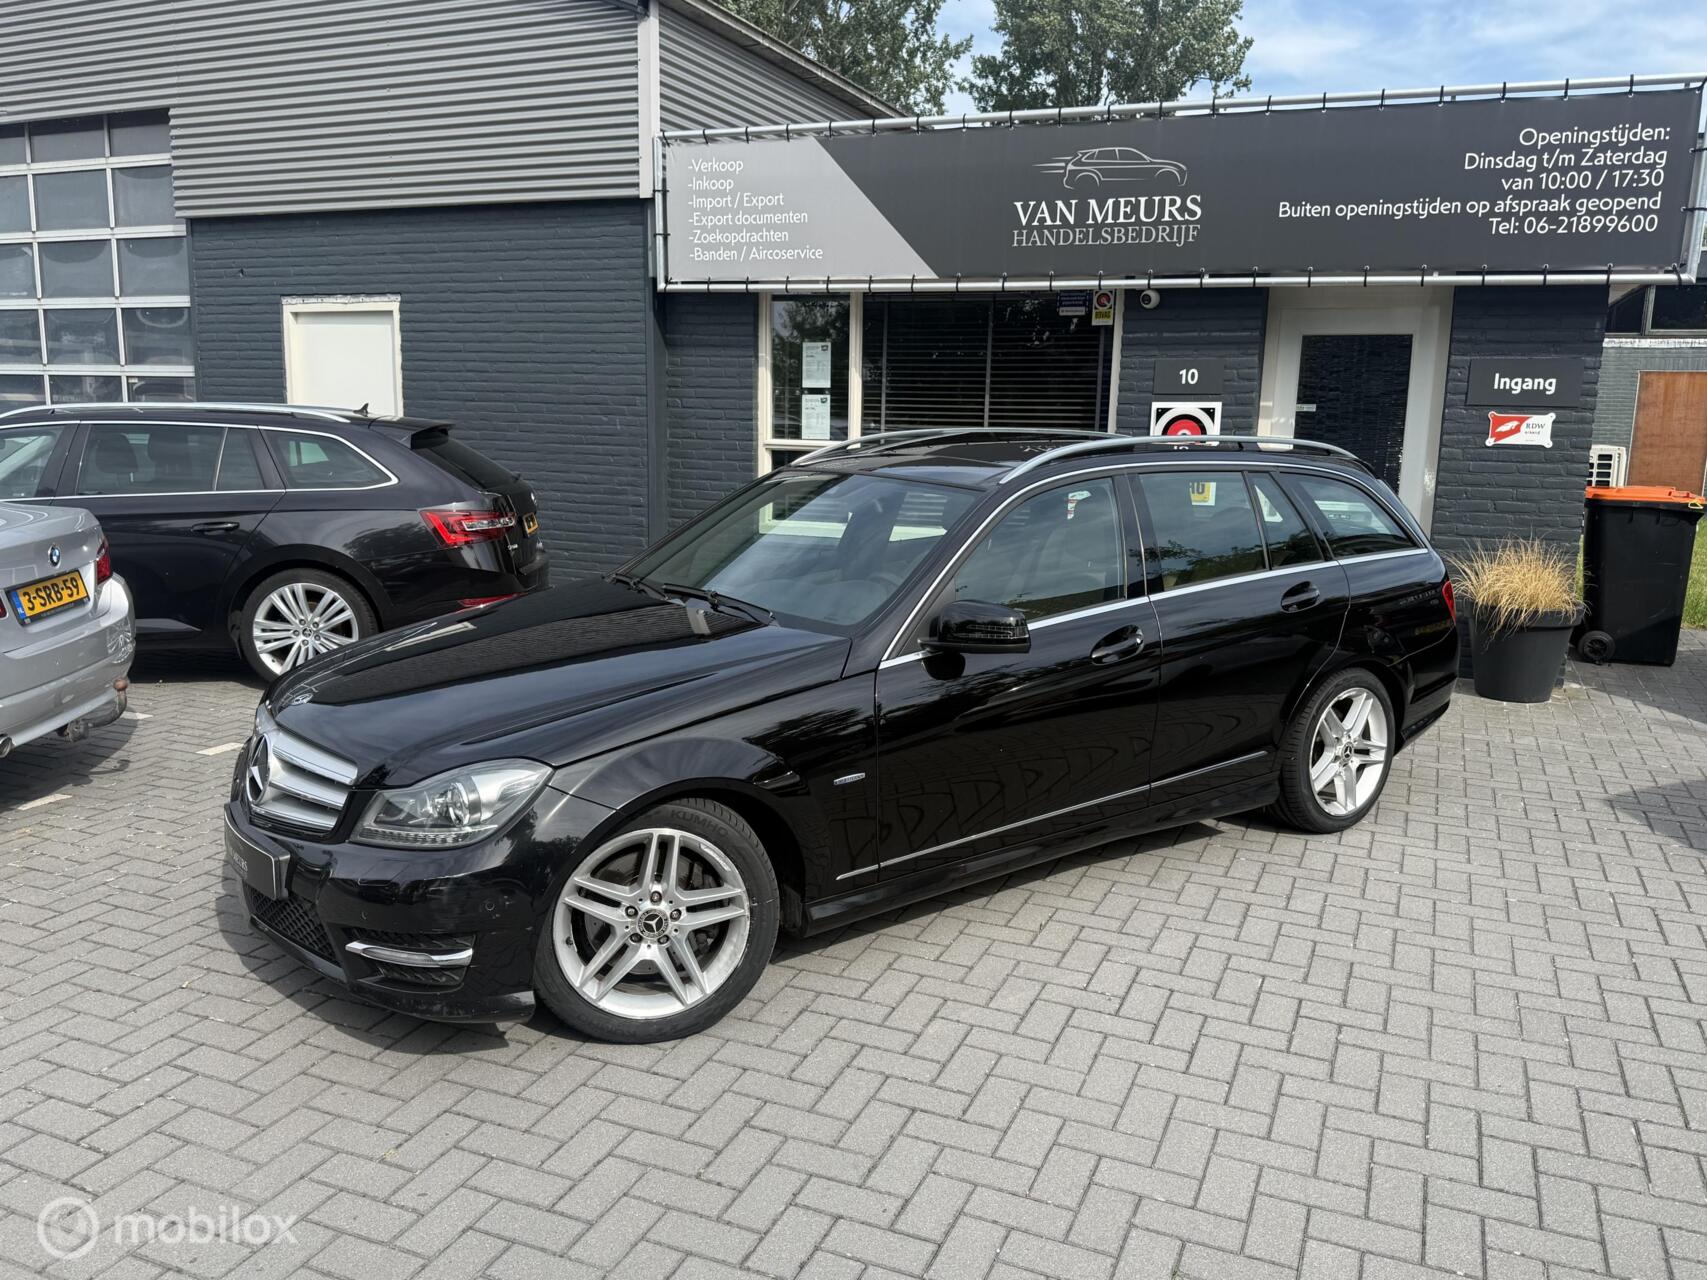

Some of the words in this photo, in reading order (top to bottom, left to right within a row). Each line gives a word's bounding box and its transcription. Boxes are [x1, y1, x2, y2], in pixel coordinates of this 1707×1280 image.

[1519, 123, 1671, 149] Openingstijden:
[687, 157, 743, 175] -Verkoop
[1464, 150, 1537, 172] Dinsdag
[1542, 149, 1575, 169] t/m
[1580, 146, 1667, 168] Zaterdag
[687, 176, 734, 193] -Inkoop
[1502, 177, 1533, 190] van
[1539, 170, 1592, 190] 10:00
[1596, 169, 1607, 190] /
[1612, 168, 1665, 188] 17:30
[688, 194, 732, 211] -Import
[734, 192, 741, 208] /
[743, 193, 784, 210] Export
[1013, 199, 1079, 226] VAN
[1086, 195, 1202, 224] MEURS
[1278, 201, 1331, 218] Buiten
[1335, 197, 1461, 220] openingstijden
[1466, 200, 1490, 217] op
[1494, 194, 1571, 216] afspraak
[1575, 191, 1662, 215] geopend
[688, 212, 732, 228] -Export
[735, 211, 808, 225] documenten
[1489, 217, 1519, 235] Tel:
[1524, 214, 1658, 234] 06-21899600
[688, 228, 789, 246] -Zoekopdrachten
[1012, 224, 1201, 247] HANDELSBEDRIJF
[689, 247, 738, 261] -Banden
[740, 246, 747, 262] /
[749, 246, 823, 260] Aircoservice
[1179, 368, 1199, 385] 10
[1493, 372, 1557, 395] Ingang
[22, 576, 80, 611] 3-SRB-59
